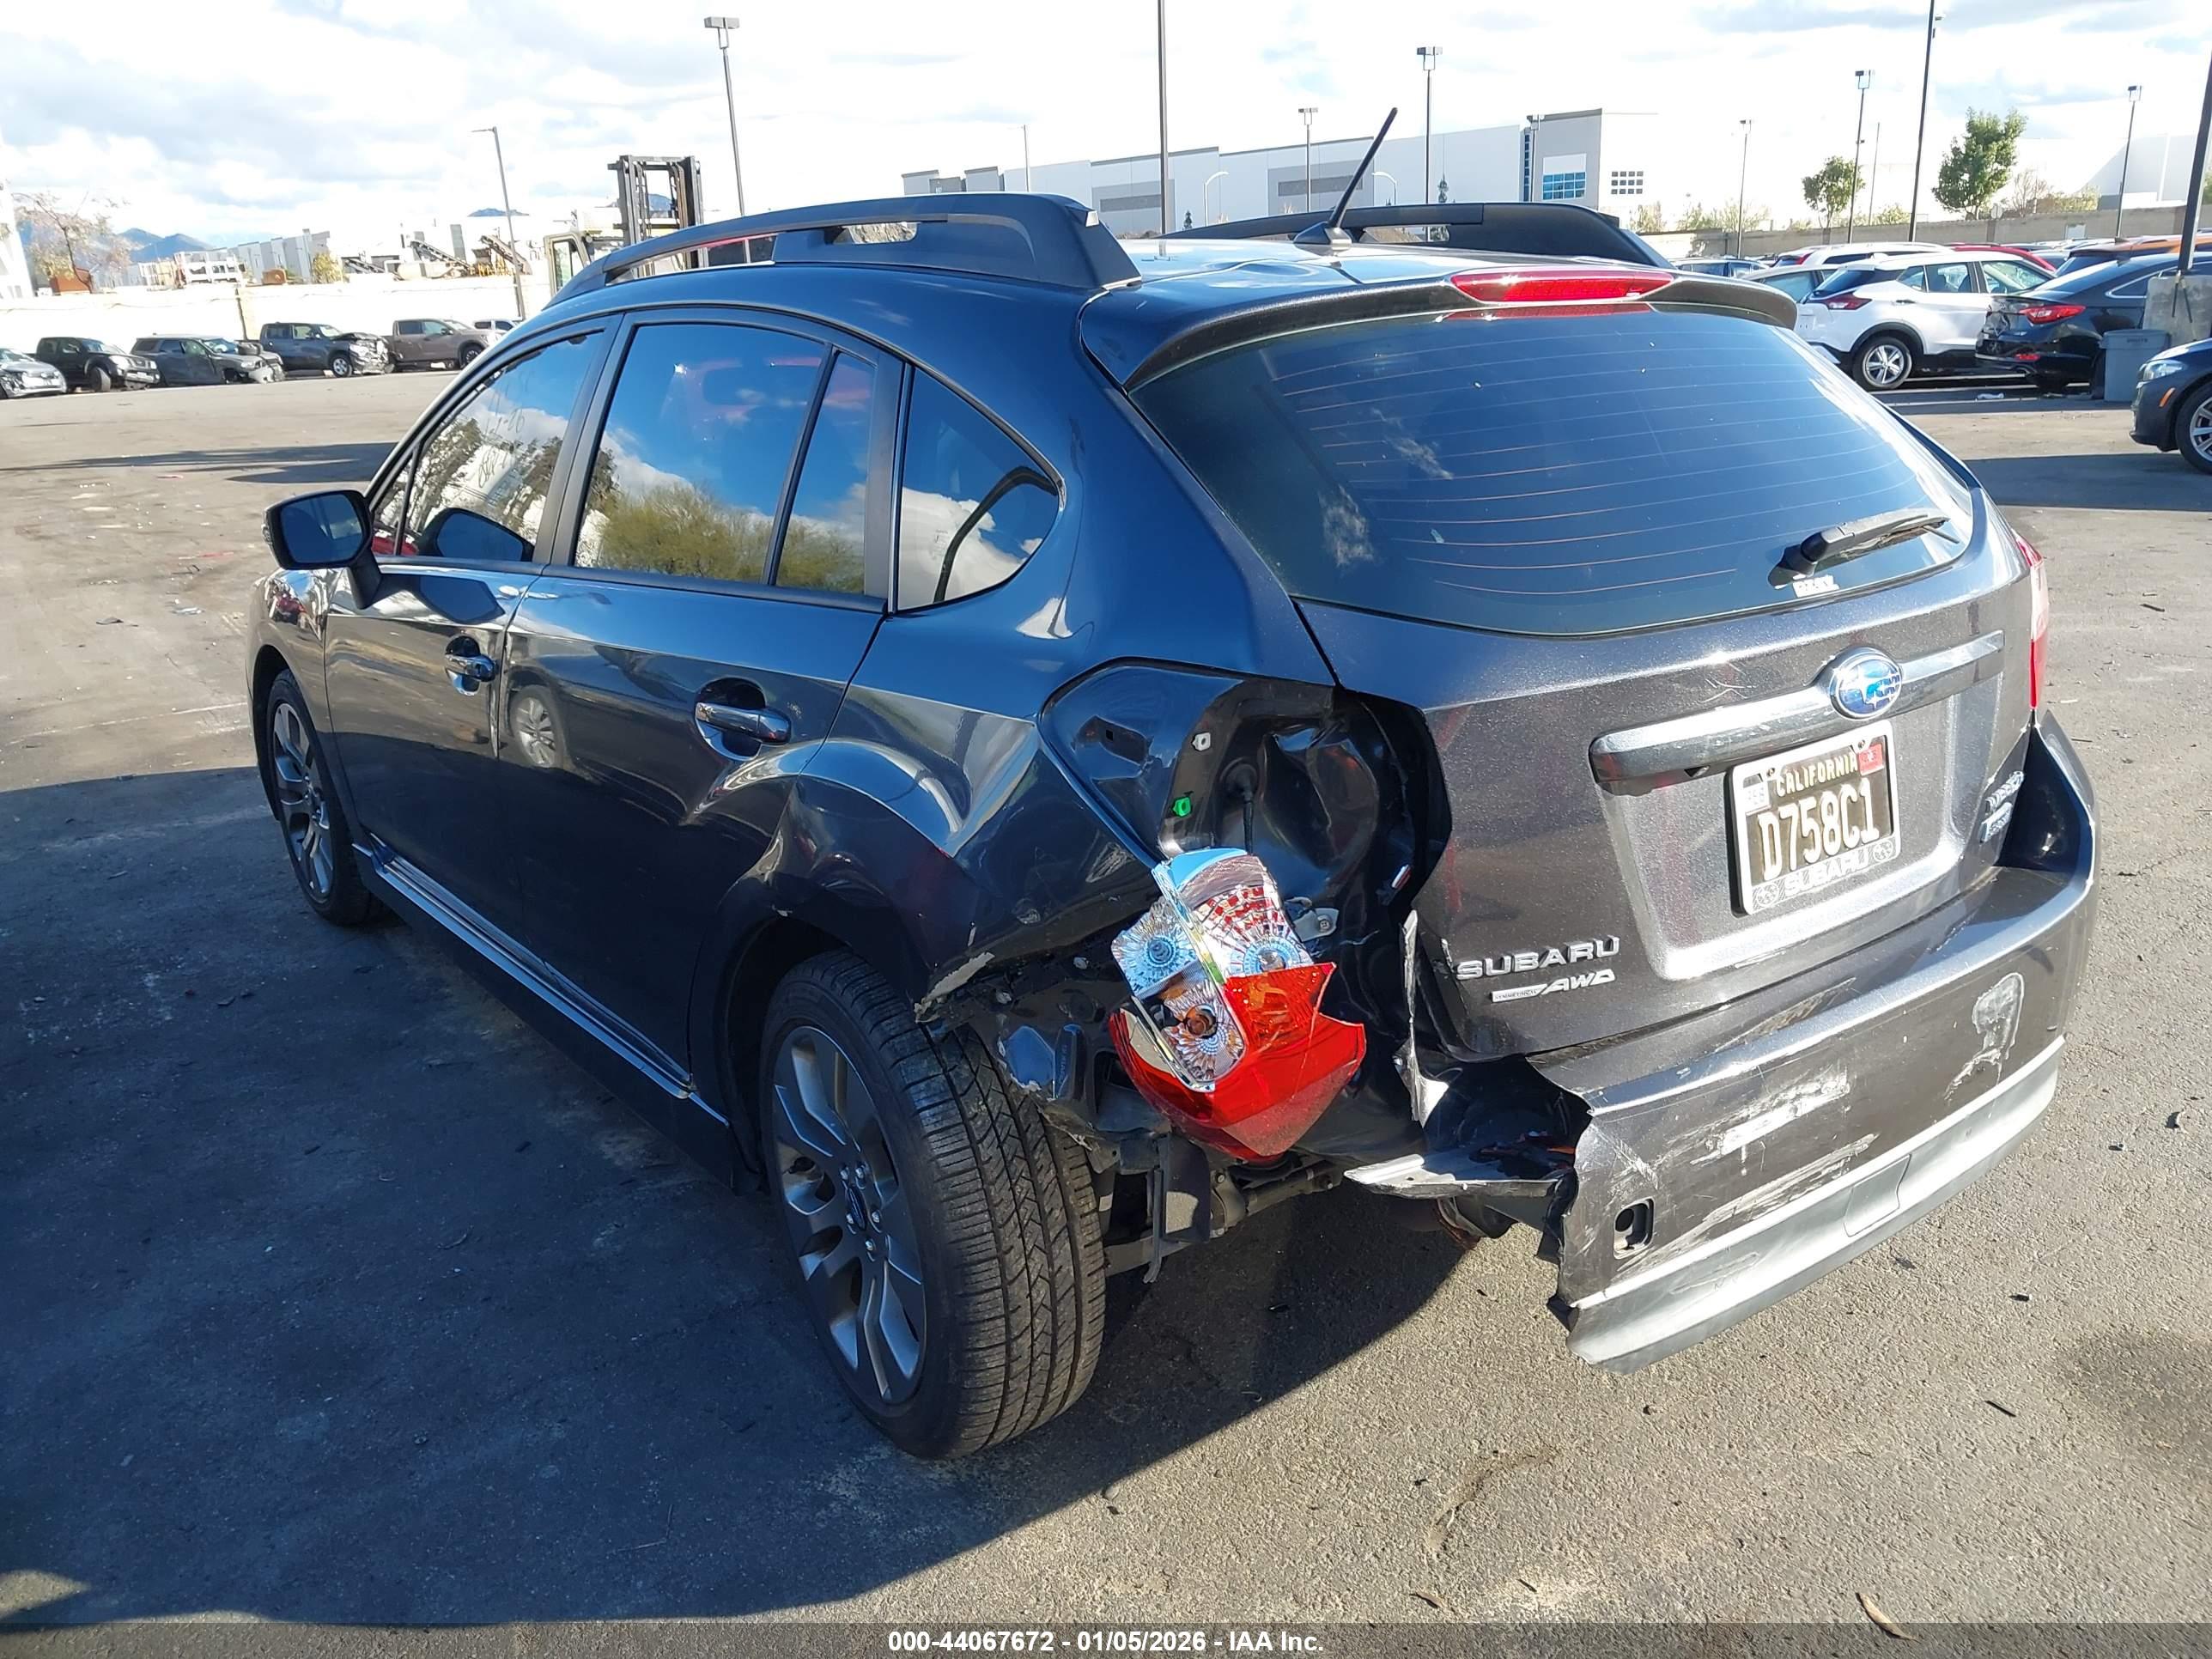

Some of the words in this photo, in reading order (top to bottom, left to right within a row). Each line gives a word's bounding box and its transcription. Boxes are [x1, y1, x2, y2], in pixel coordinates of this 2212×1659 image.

[1776, 750, 1858, 797] CALIFORNIA
[1757, 776, 1880, 881] D758C1
[1784, 848, 1869, 896] SUBARU
[1456, 934, 1621, 981] SUBARU
[1540, 969, 1616, 995] AWD
